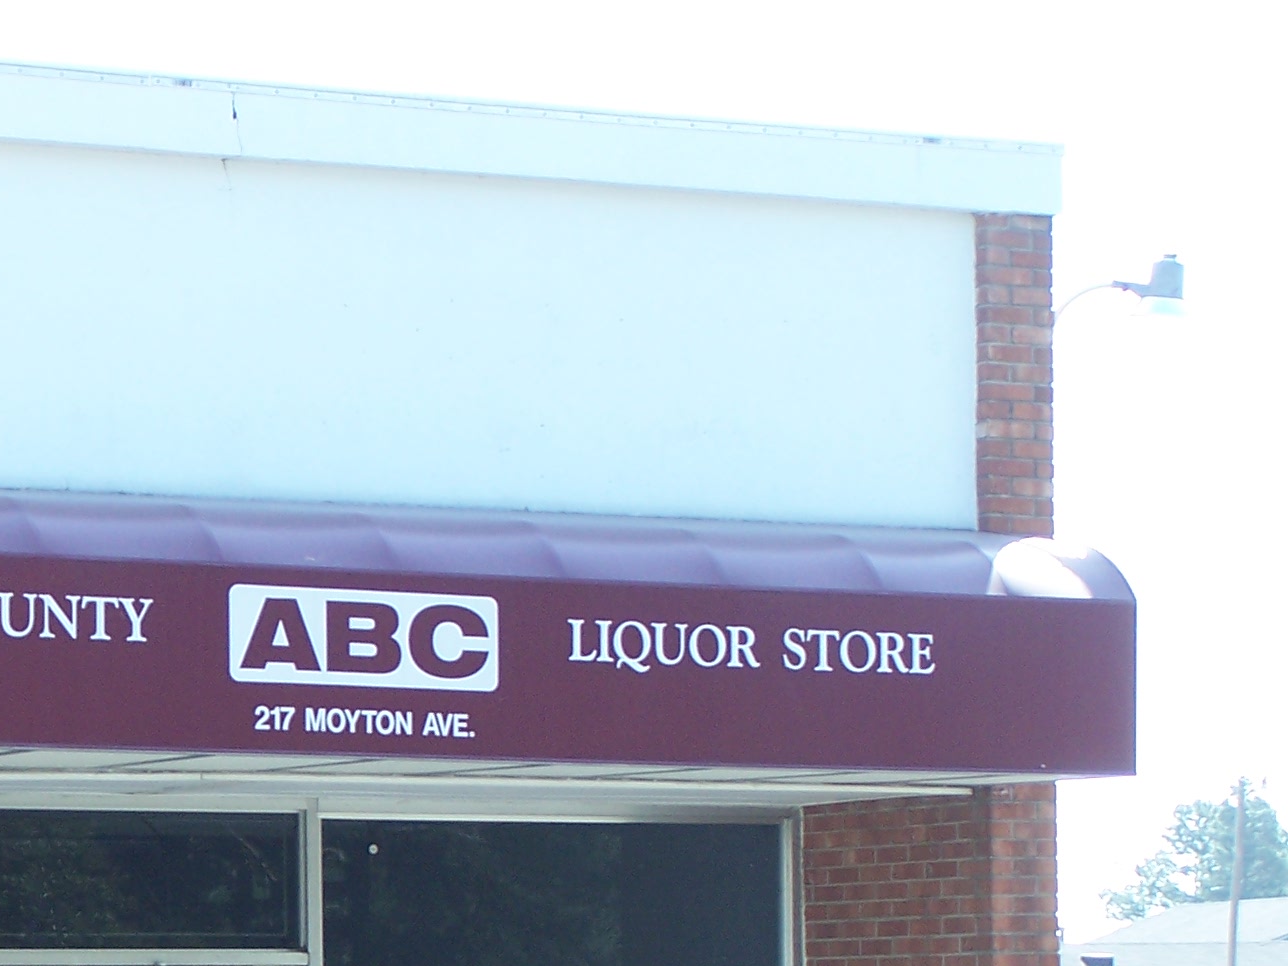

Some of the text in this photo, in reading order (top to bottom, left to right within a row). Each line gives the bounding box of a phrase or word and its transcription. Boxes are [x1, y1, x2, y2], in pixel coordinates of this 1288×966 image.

[239, 597, 490, 680] ABC
[567, 618, 935, 675] LIQUOR STORE
[254, 705, 476, 738] 217 MOYTON AVE.
